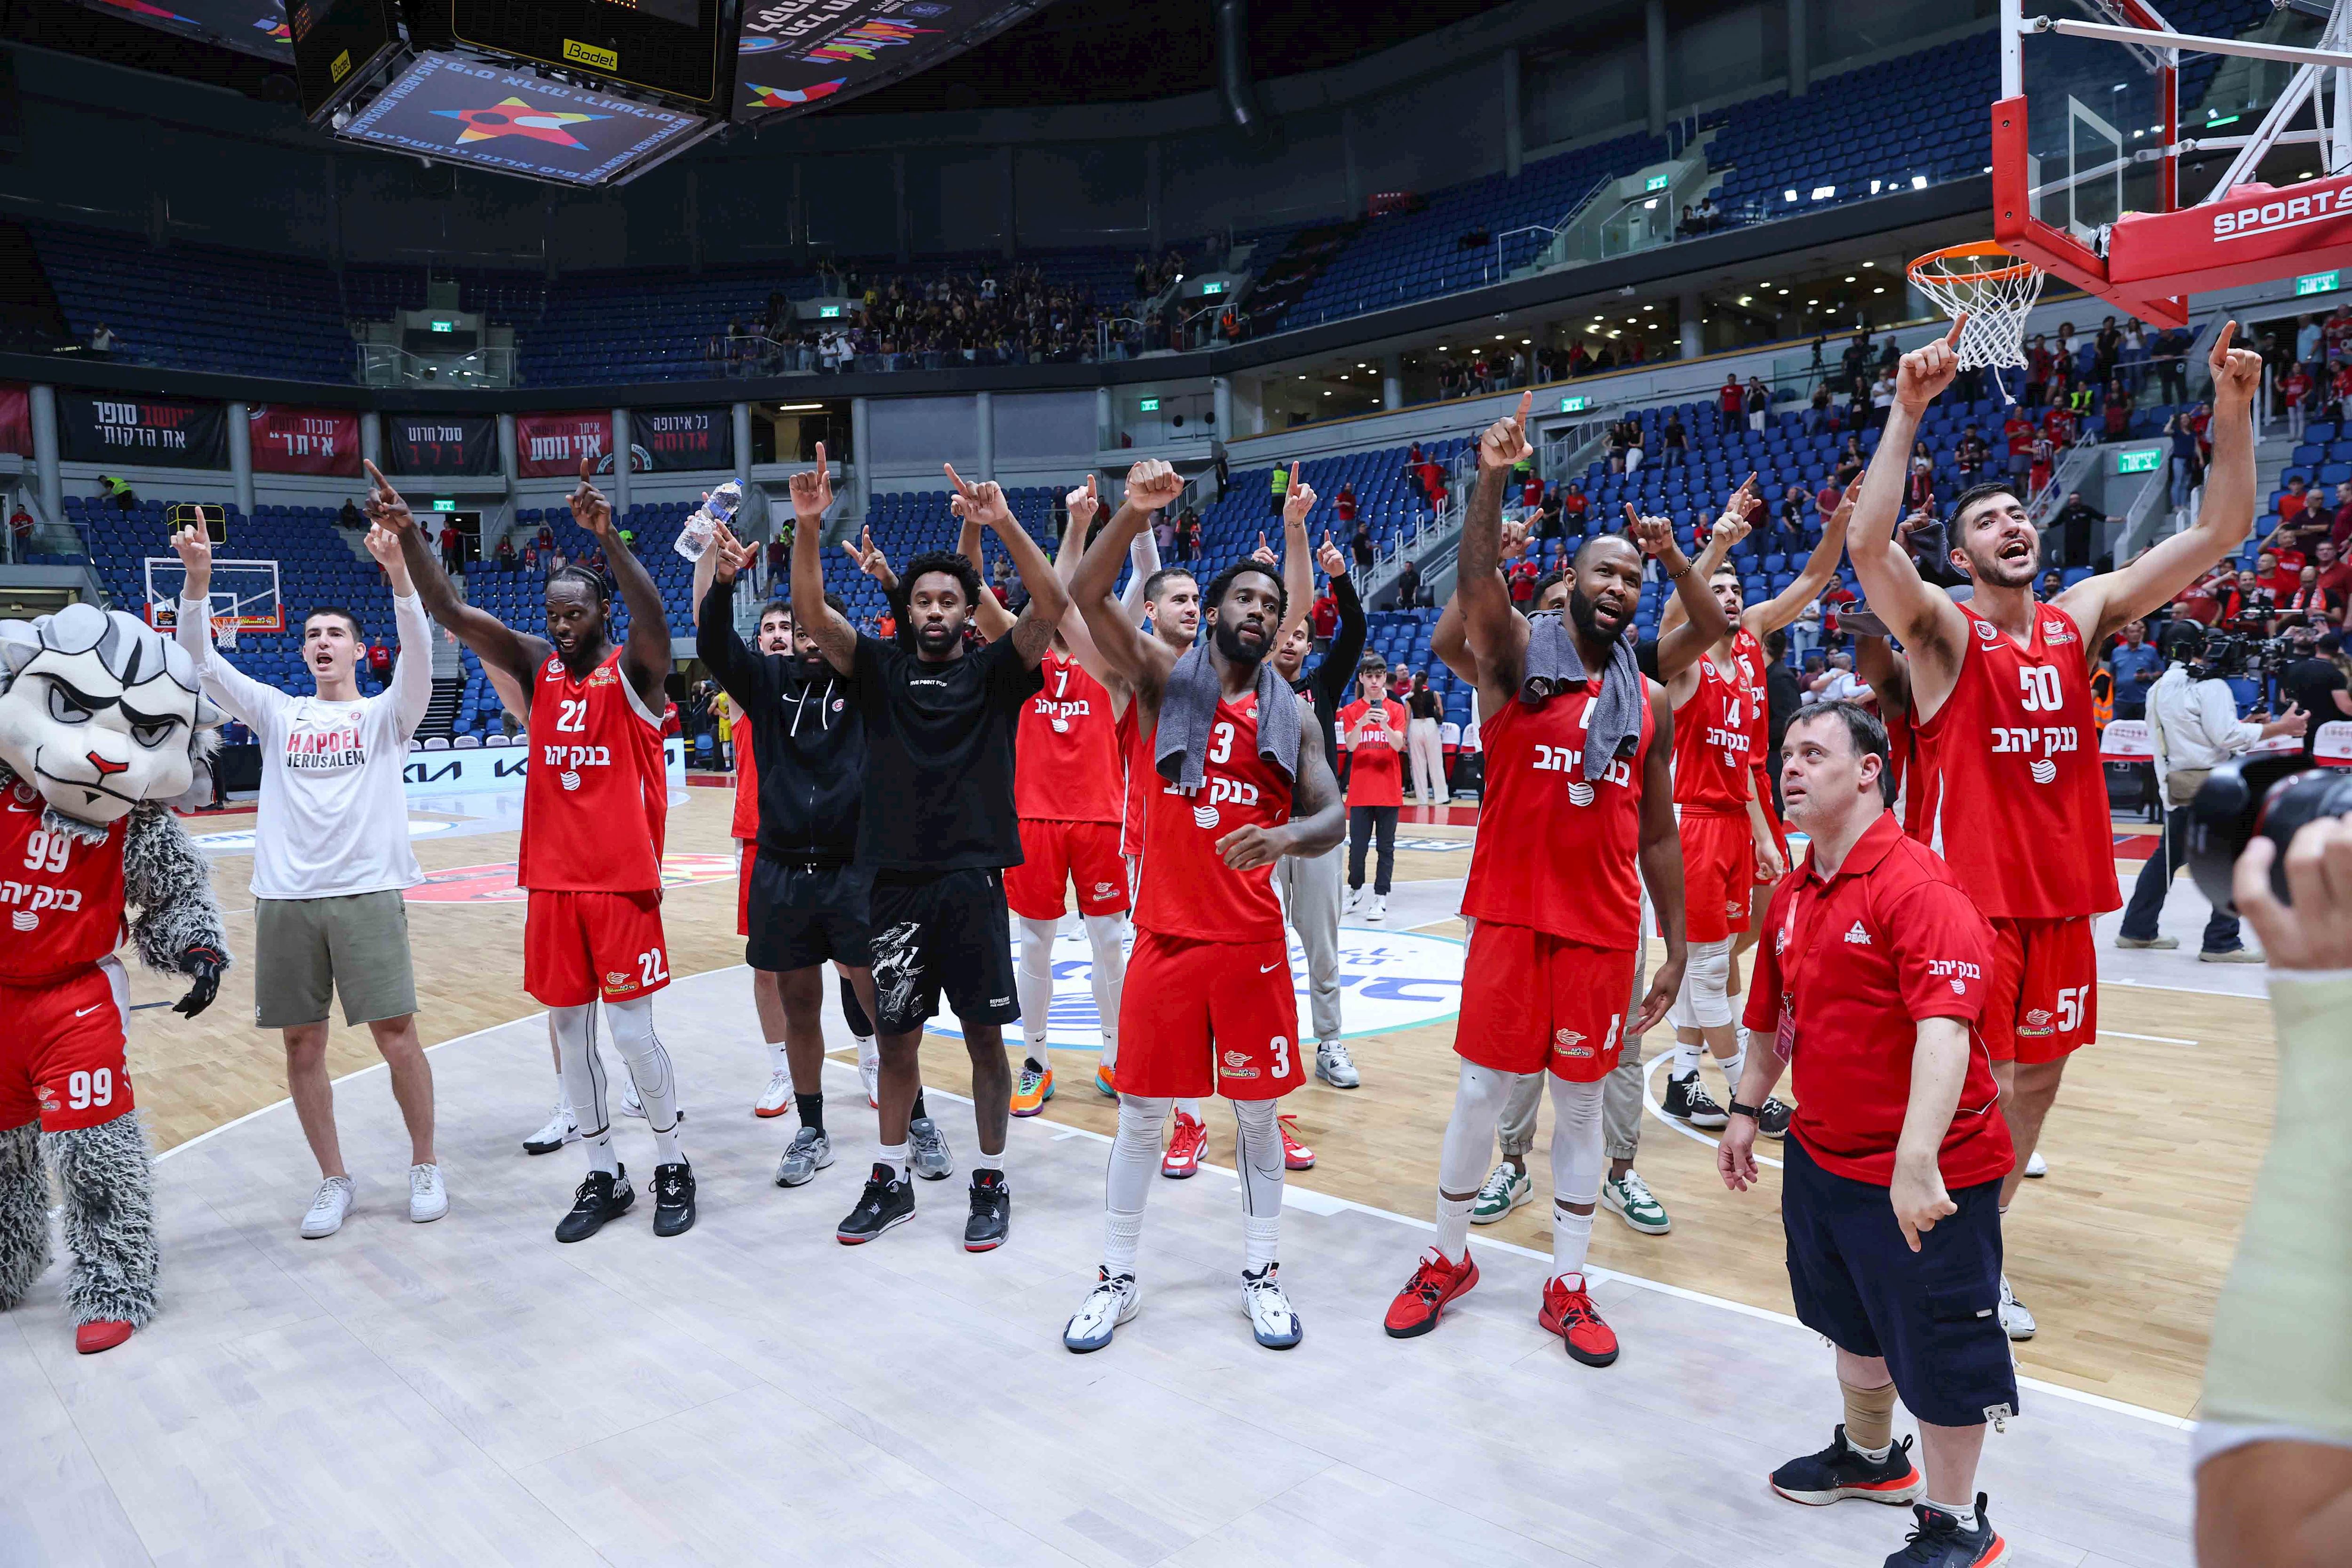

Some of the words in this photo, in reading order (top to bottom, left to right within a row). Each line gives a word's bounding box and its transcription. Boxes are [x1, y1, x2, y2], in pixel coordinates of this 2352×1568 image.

[415, 56, 445, 76] PAIS
[567, 43, 614, 67] Bodet
[388, 74, 425, 99] ARENA
[445, 62, 496, 80] פיס
[574, 95, 676, 122] ירושלים
[346, 96, 398, 134] JERUSALEM
[580, 169, 607, 181] PAIS
[630, 119, 693, 154] JERUSALEM
[539, 166, 580, 178] פיס
[2300, 274, 2335, 294] יציאה
[92, 401, 137, 425] סופר
[653, 416, 692, 431] אירופה
[696, 414, 708, 429] כל
[163, 430, 185, 448] את
[408, 427, 436, 442] חרוט
[437, 426, 462, 441] סמל
[579, 422, 600, 435] איתך
[531, 436, 569, 461] נוסע
[574, 434, 602, 458] אני
[653, 432, 708, 452] אדומה
[2122, 451, 2157, 471] יציאה
[1055, 671, 1068, 698] 7
[2019, 665, 2063, 712] 50
[556, 699, 587, 732] 22
[1034, 699, 1058, 715] יהב
[1061, 700, 1090, 719] בנק
[286, 728, 364, 754] HAPOEL
[1209, 722, 1235, 763] 3
[1727, 732, 1750, 755] בנק
[1991, 727, 2040, 753] יהב
[2046, 726, 2078, 756] בנק
[286, 750, 365, 769] JERUSALEM
[571, 746, 610, 769] בנק
[1534, 745, 1581, 773] יהב
[1209, 777, 1259, 806] בנק
[24, 831, 71, 873] 99
[0, 881, 32, 905] יה
[30, 884, 82, 912] בנק
[1844, 932, 1872, 945] PEAK
[638, 947, 668, 987] 22
[1929, 959, 1956, 975] יהב
[1957, 960, 1980, 979] בנק
[1270, 1035, 1290, 1078] 3
[69, 1067, 112, 1109] 99
